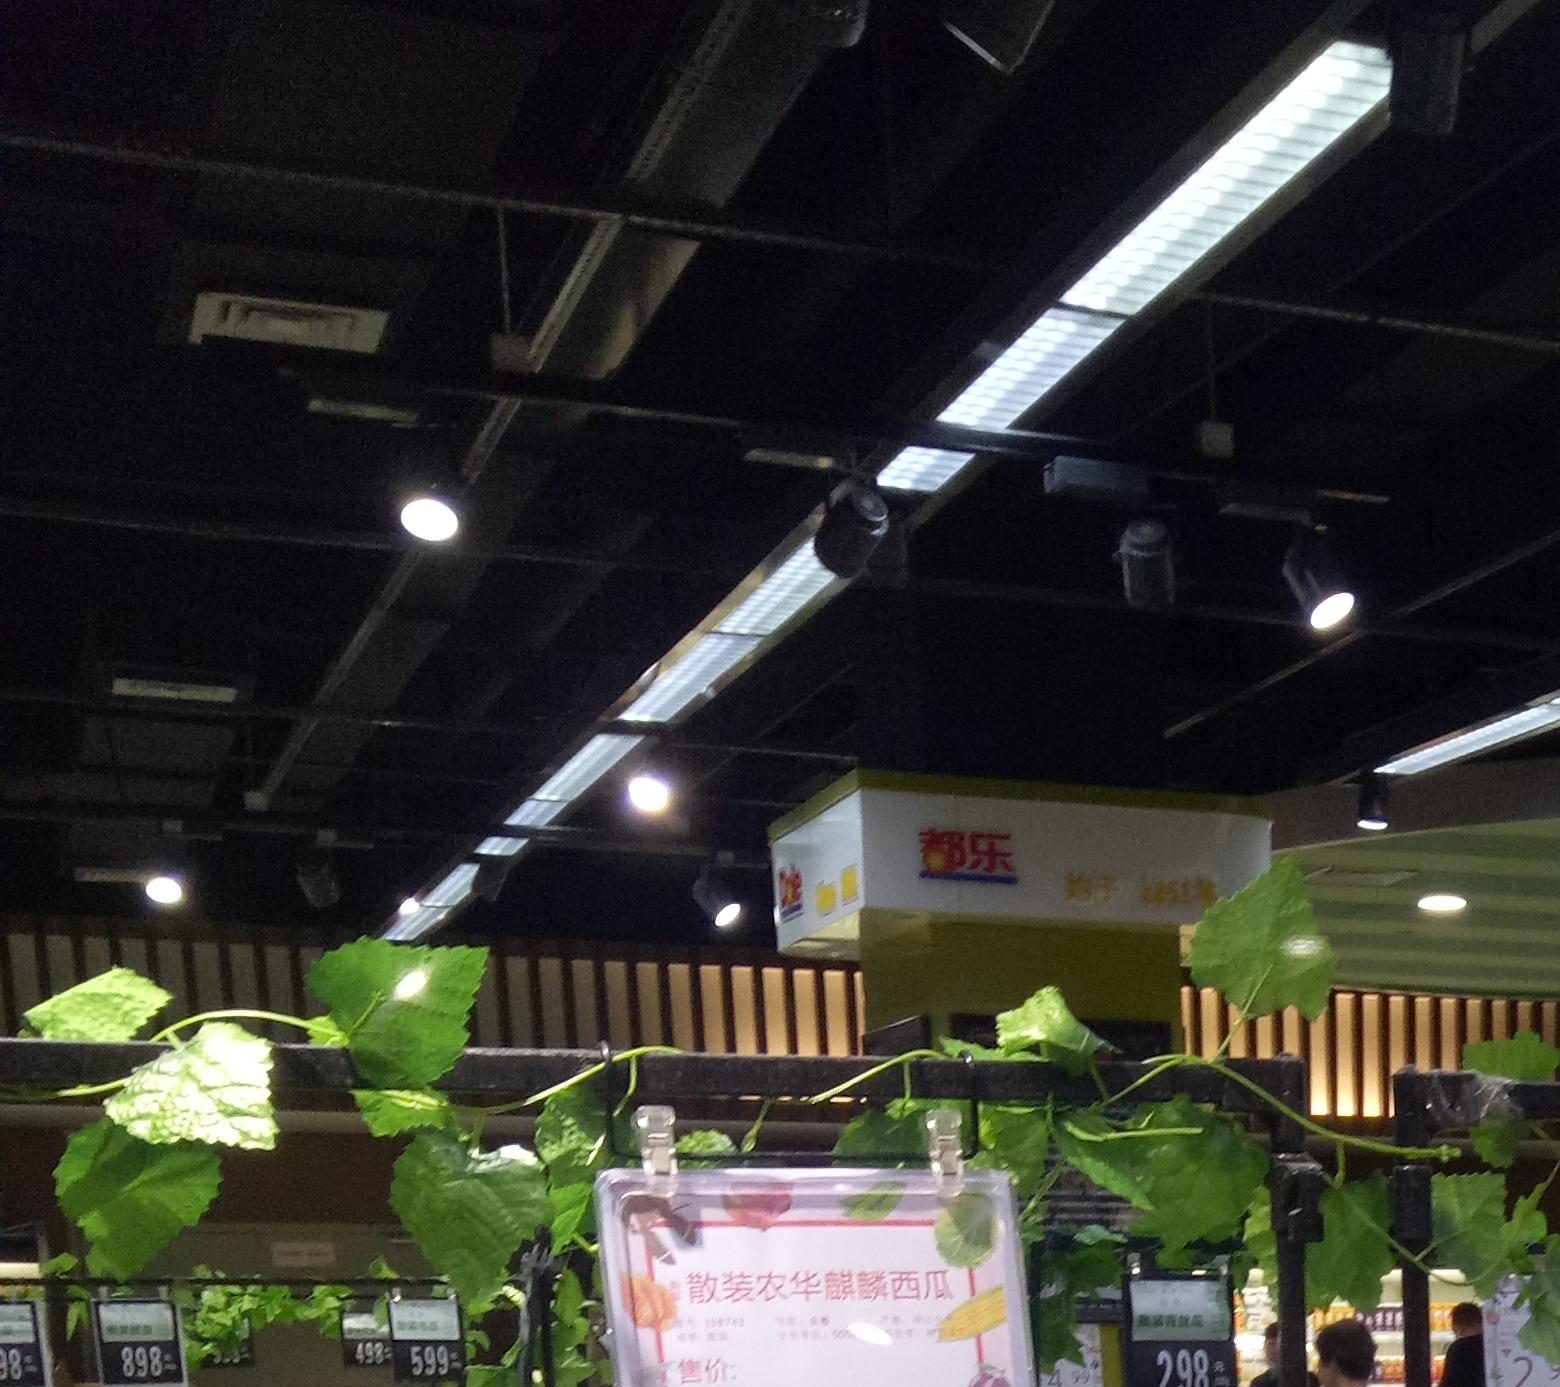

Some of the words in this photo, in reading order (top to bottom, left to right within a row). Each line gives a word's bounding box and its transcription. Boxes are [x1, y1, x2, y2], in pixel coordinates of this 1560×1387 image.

[919, 827, 1015, 875] 都乐
[686, 1268, 953, 1305] 散装农华麒麟西瓜
